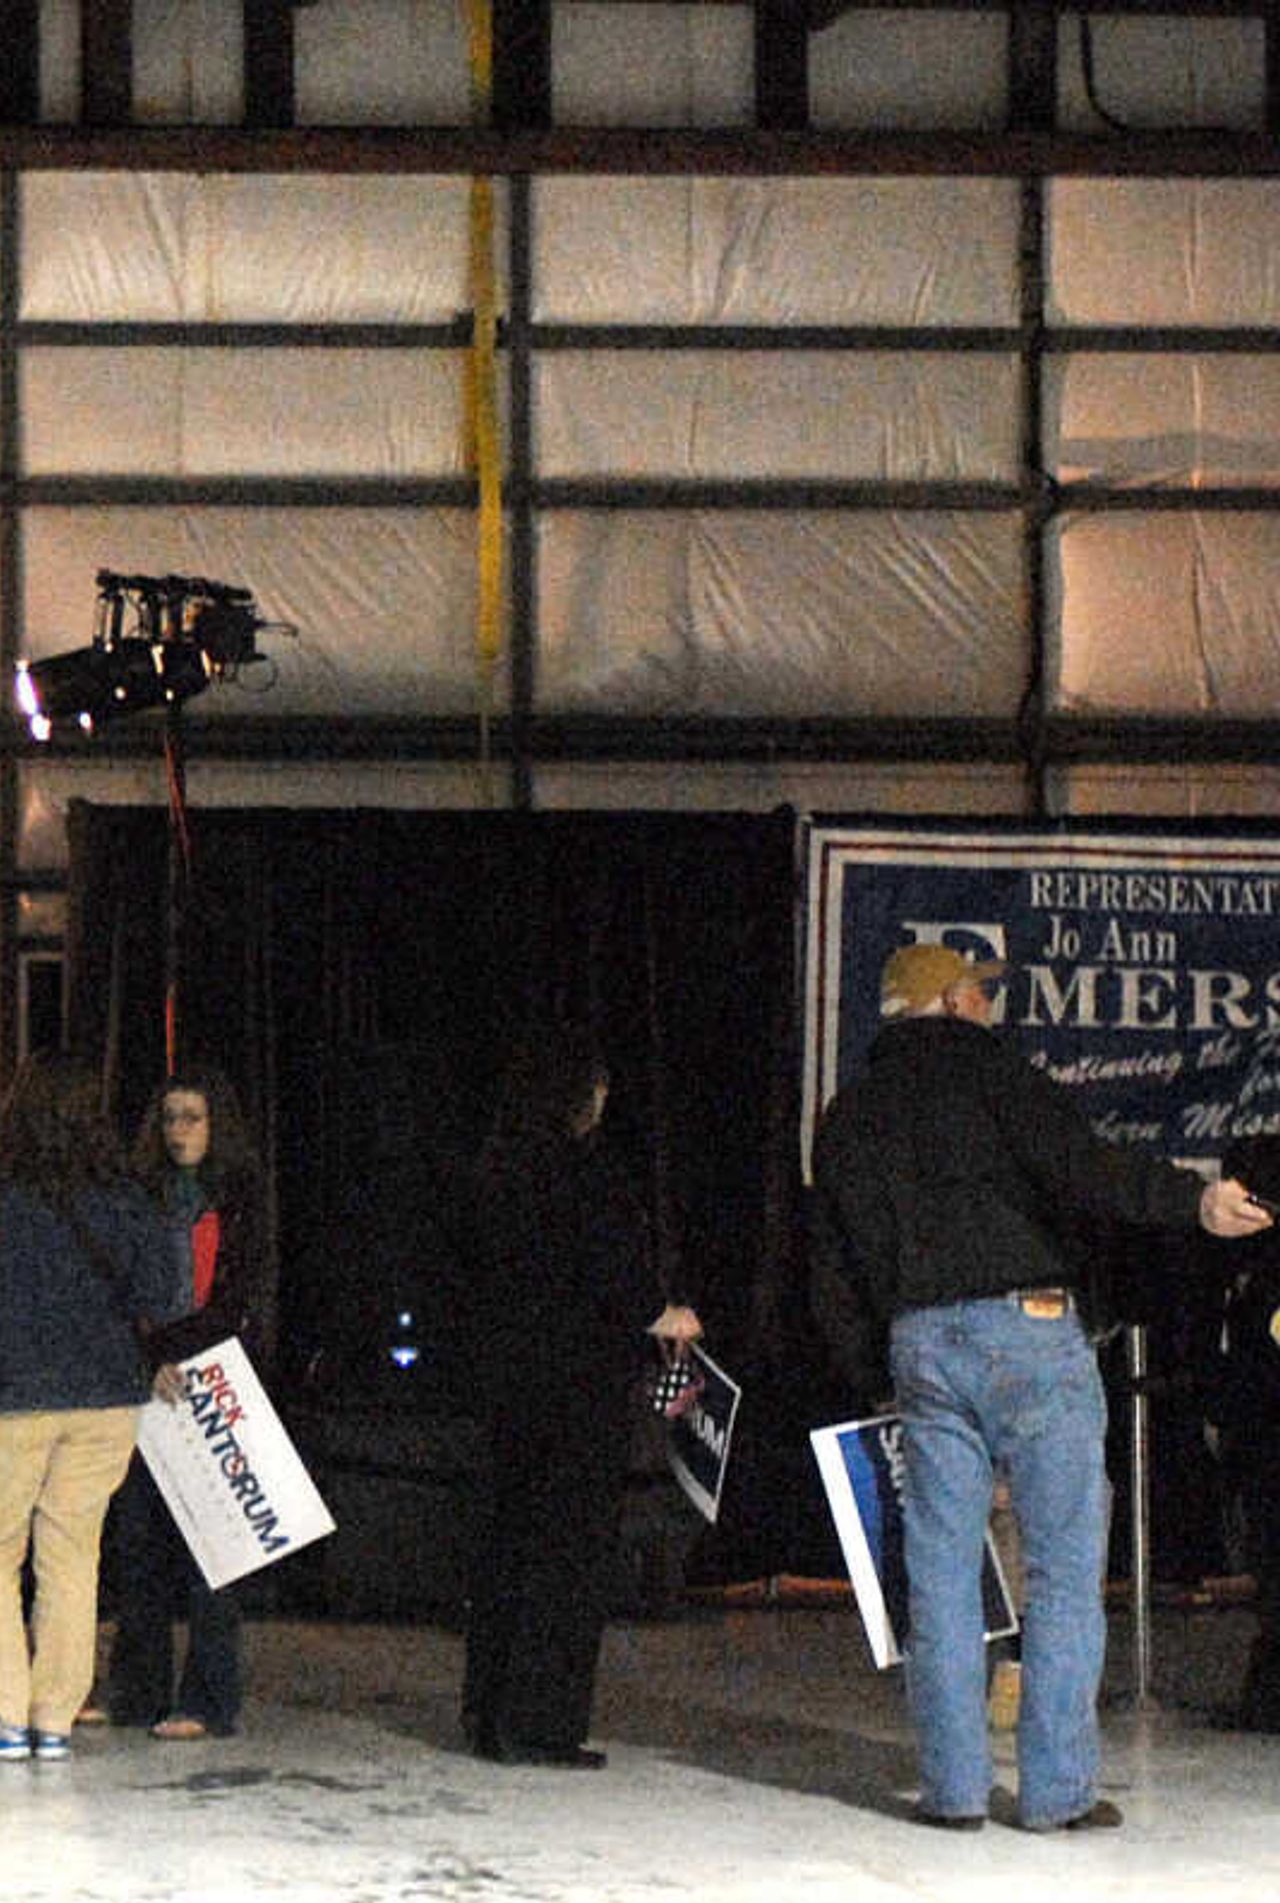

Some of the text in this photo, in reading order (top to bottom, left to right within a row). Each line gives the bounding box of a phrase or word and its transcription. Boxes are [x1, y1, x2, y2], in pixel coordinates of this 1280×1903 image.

[1043, 914, 1178, 962] Jo Ann
[201, 1363, 247, 1428] RICK
